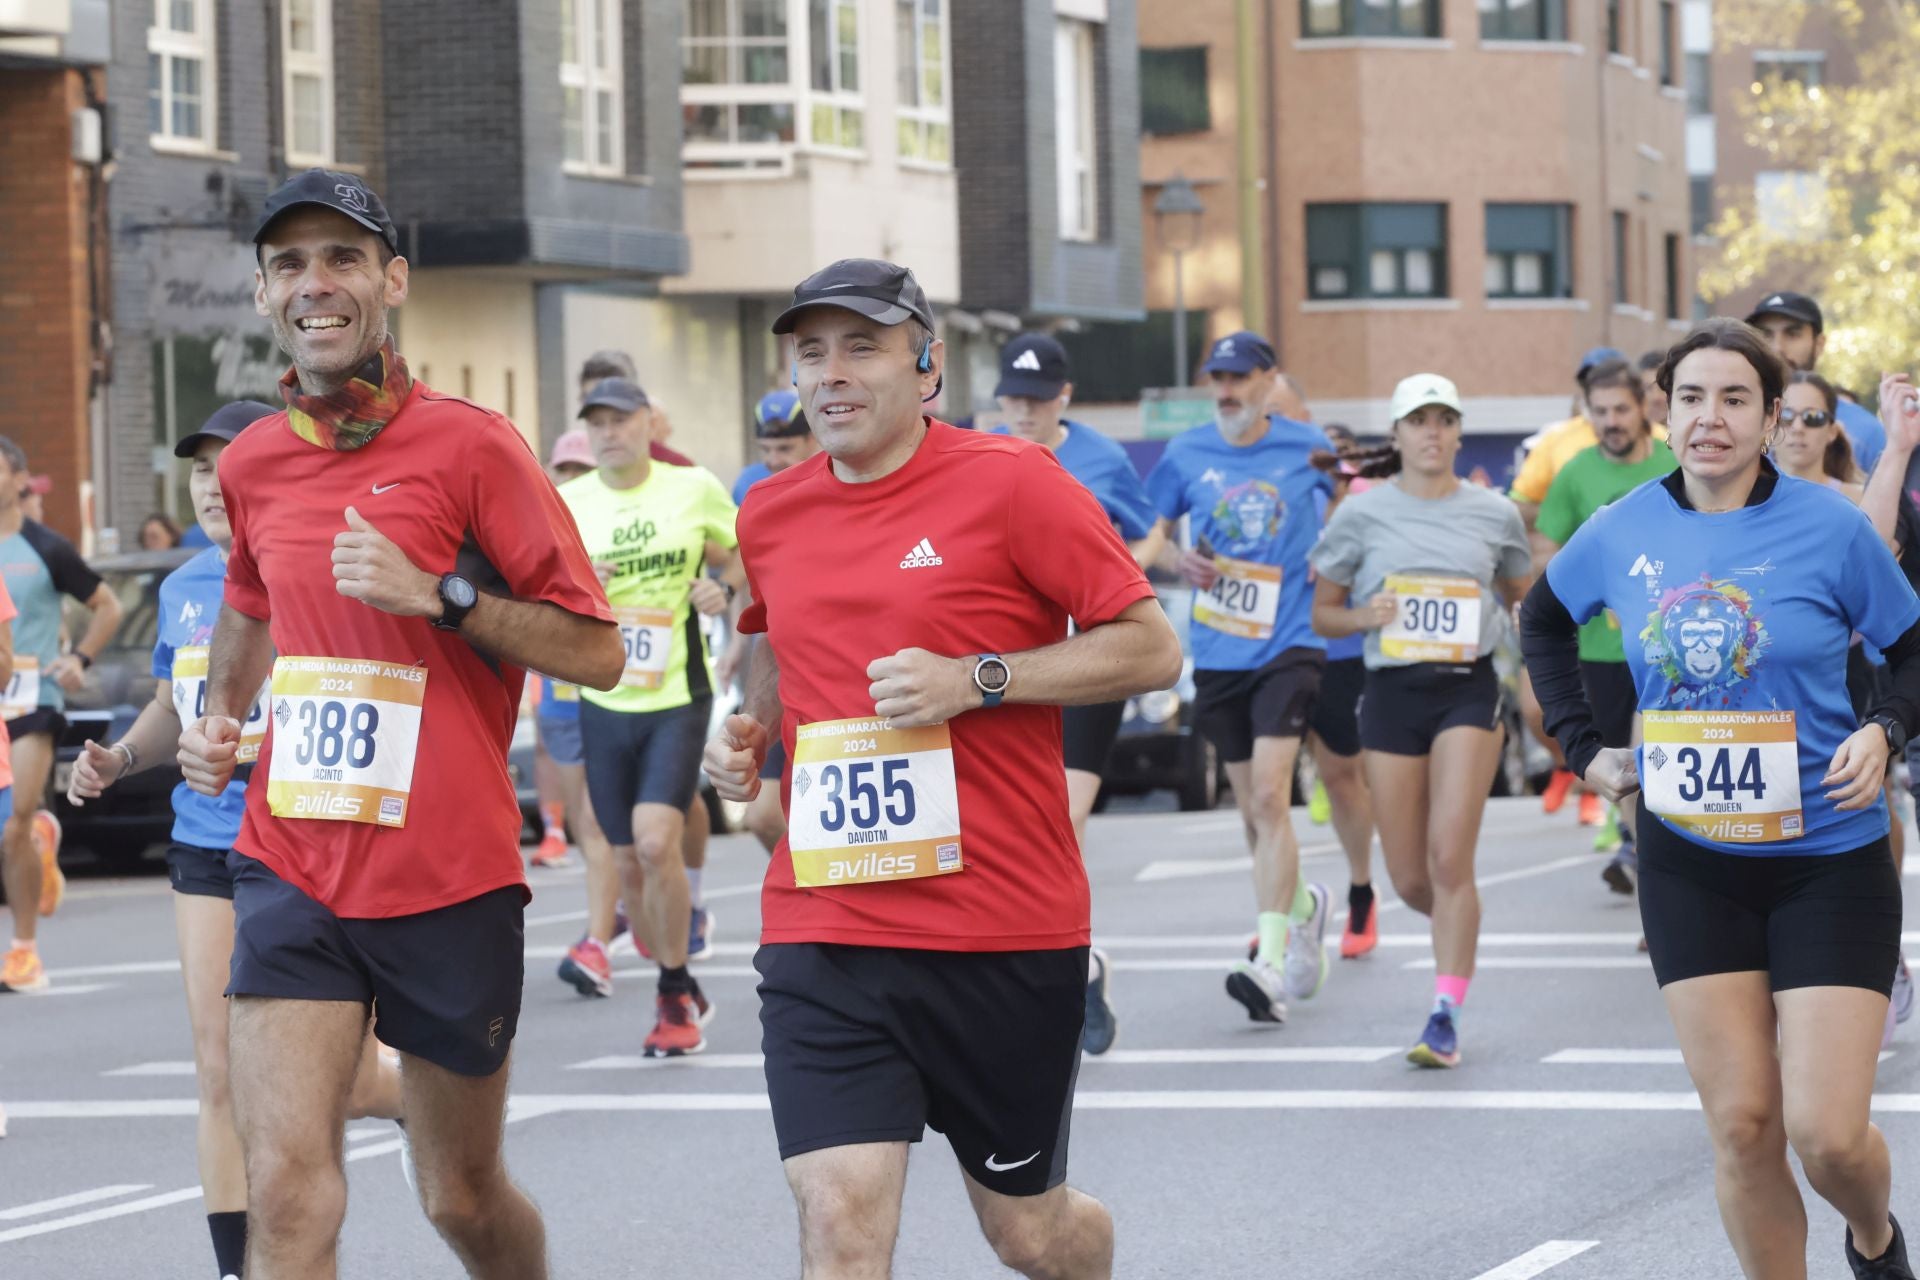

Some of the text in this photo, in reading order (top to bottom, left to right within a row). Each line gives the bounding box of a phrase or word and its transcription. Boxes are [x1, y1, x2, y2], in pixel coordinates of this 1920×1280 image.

[612, 518, 657, 547] edp
[613, 549, 687, 577] CTURNA
[899, 556, 943, 569] adidas
[1212, 576, 1258, 613] 420
[1403, 598, 1458, 633] 309
[621, 627, 651, 661] 56
[300, 662, 326, 674] MEDIA
[327, 662, 380, 675] MARATÓN
[383, 668, 423, 682] AVILÉS
[320, 678, 353, 692] 2024
[820, 725, 846, 737] MEDIA
[847, 718, 893, 734] MARATÓ
[1675, 714, 1705, 724] MEDIA
[1707, 712, 1757, 724] MARATÓN
[1758, 712, 1792, 723] AVILÉS
[295, 700, 379, 769] 388
[843, 738, 877, 753] 2024
[1702, 728, 1734, 740] 2024
[312, 768, 343, 782] JACINTO
[1677, 746, 1767, 802] 344
[293, 790, 364, 816] avilés
[819, 758, 916, 832] 355
[1703, 802, 1742, 813] MCQUEEN
[847, 829, 888, 844] DAVIDTM
[827, 852, 917, 880] avilés
